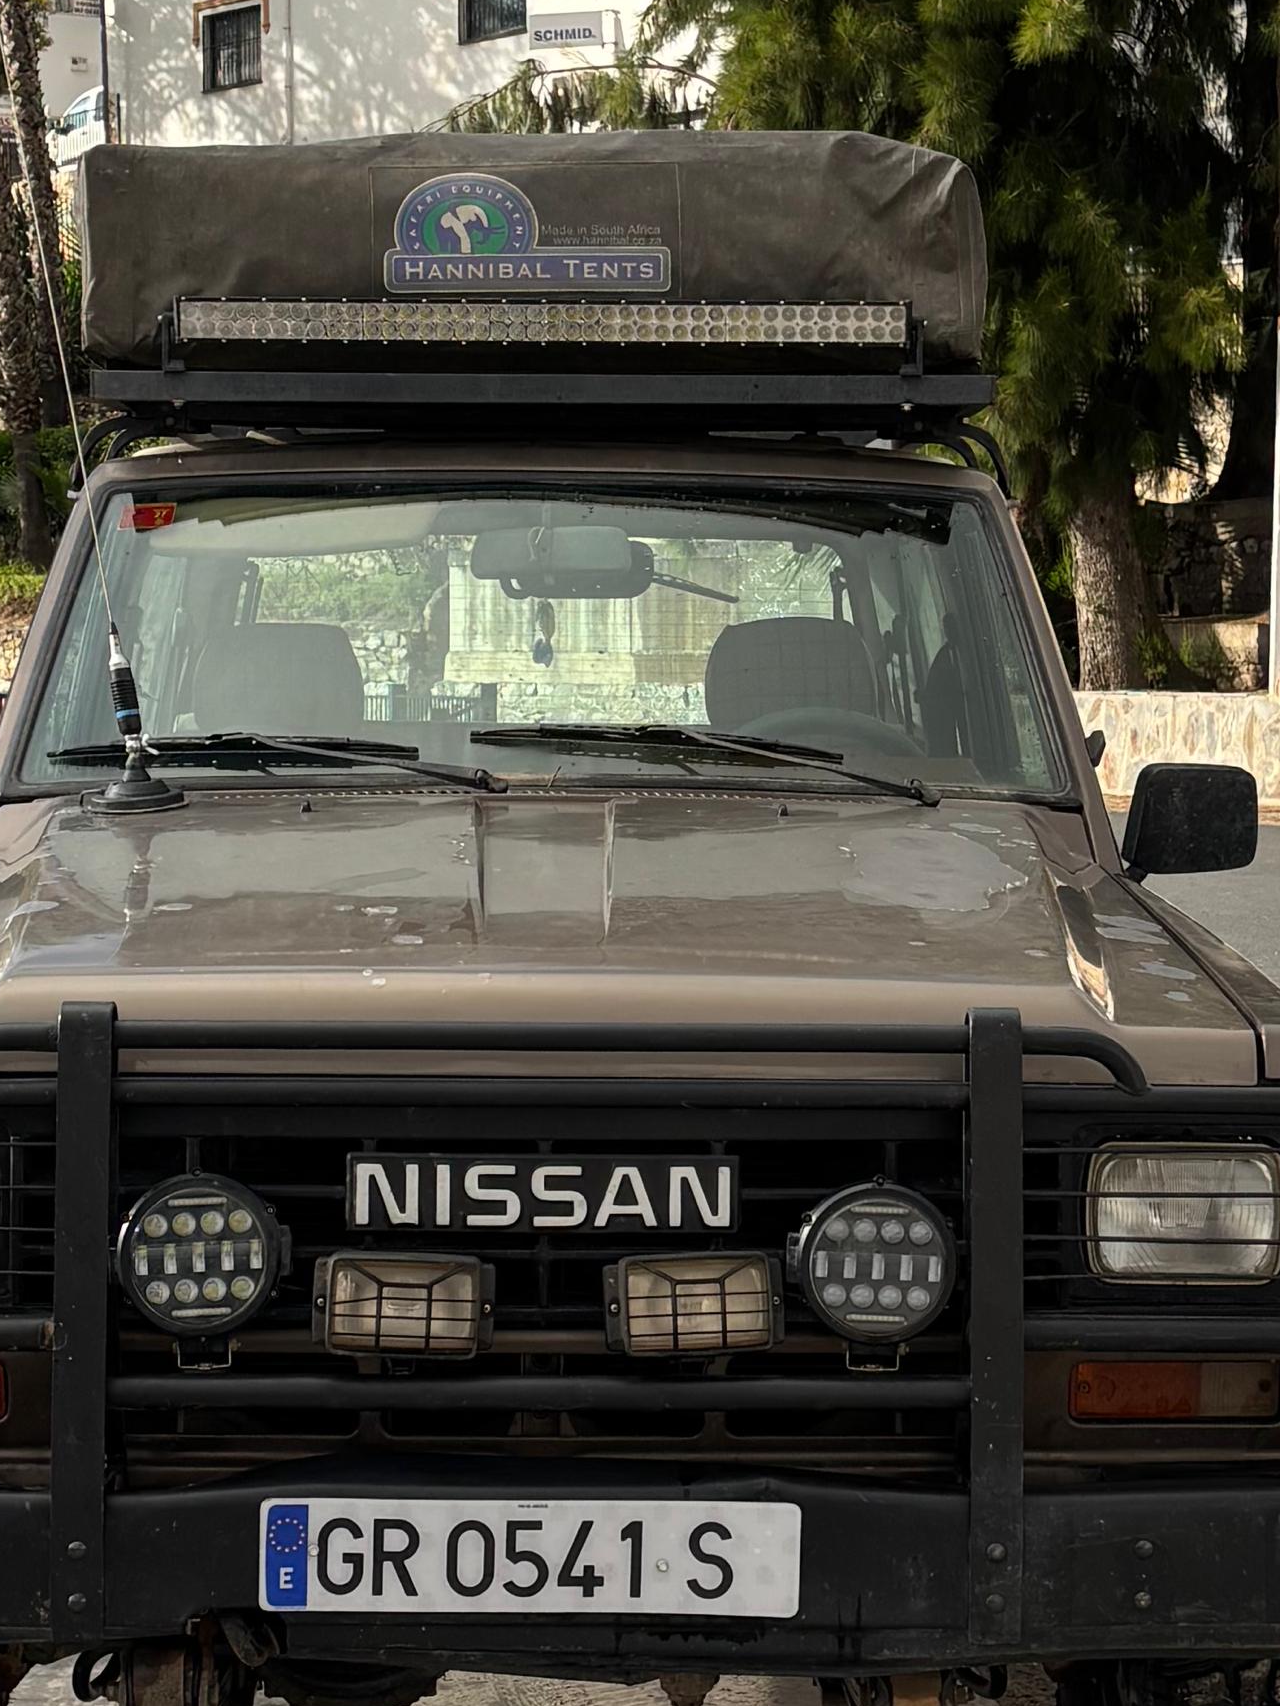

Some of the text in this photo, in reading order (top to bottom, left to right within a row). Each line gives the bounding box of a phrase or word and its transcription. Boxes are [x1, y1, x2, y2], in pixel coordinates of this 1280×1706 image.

[451, 184, 524, 249] EQUIPMENT
[541, 224, 661, 236] Made in South Africa
[355, 1161, 734, 1230] NISSAN
[279, 1517, 734, 1600] E GR 0541 S
